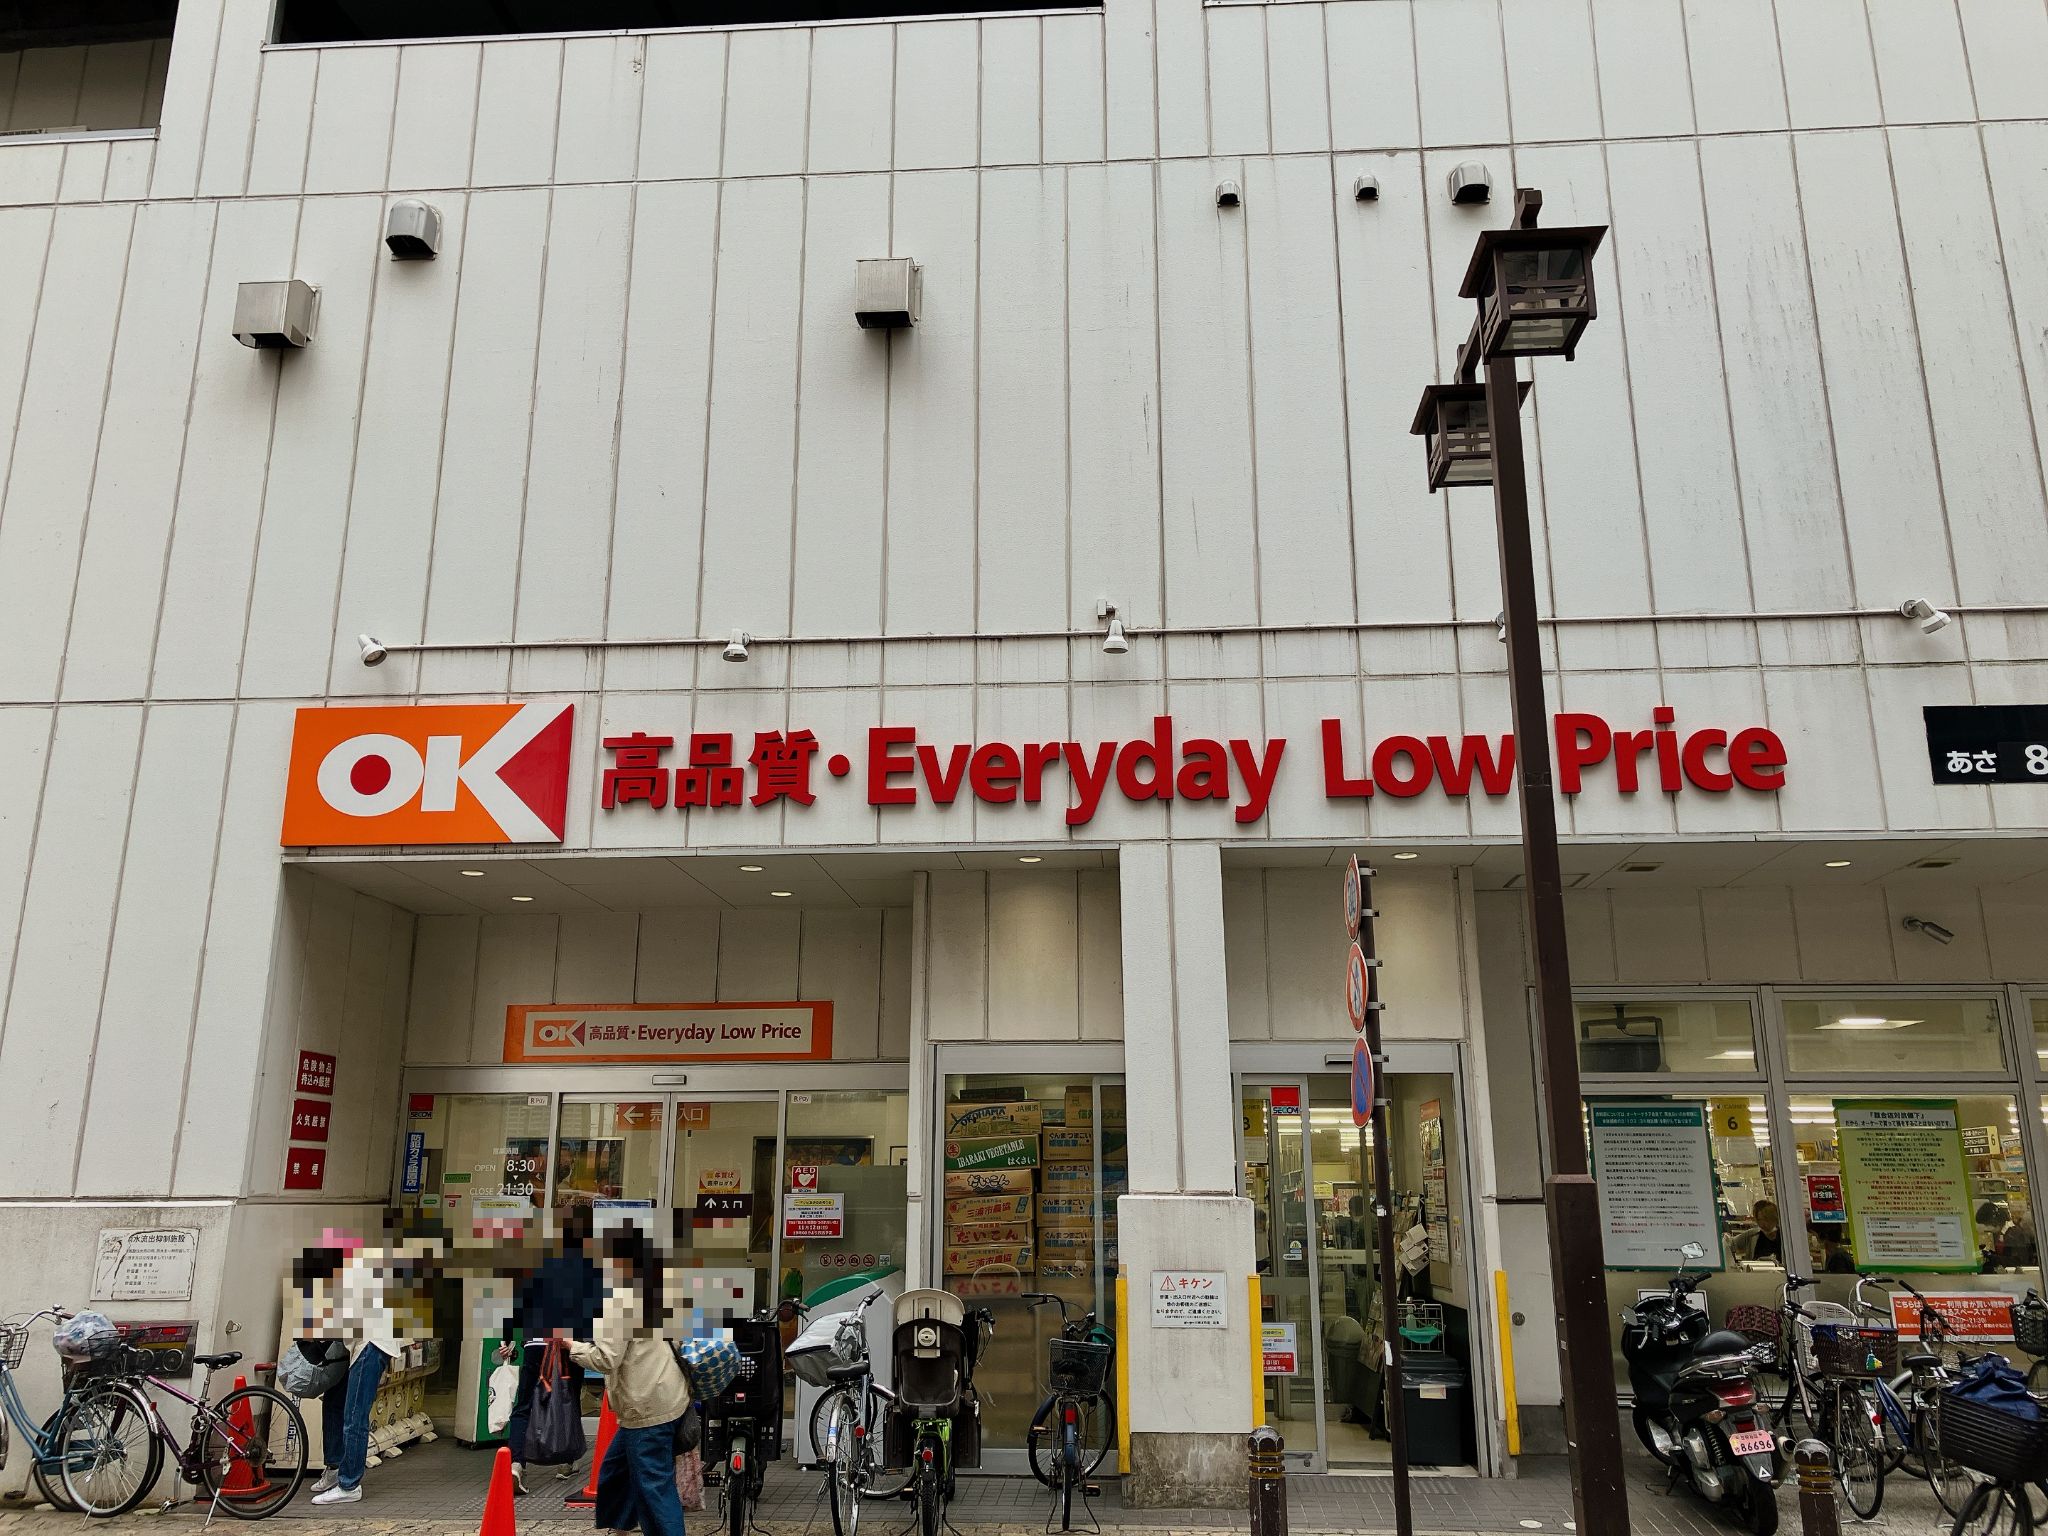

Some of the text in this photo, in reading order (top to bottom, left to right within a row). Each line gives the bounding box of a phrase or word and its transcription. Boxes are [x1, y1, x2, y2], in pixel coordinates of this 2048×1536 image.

[868, 716, 1286, 824] Everyday
[1322, 719, 1516, 801] Low
[1554, 707, 1787, 794] Price
[1946, 750, 1998, 774] あさ
[317, 704, 574, 843] OK
[538, 1019, 586, 1048] OK
[638, 1024, 715, 1044] Everyday
[721, 1023, 756, 1039] Low
[762, 1023, 802, 1039] Price
[1273, 1106, 1300, 1114] SECOM
[1727, 1116, 1739, 1131] 6
[957, 1139, 1025, 1169] IBARAKI VEGETABLE
[1007, 1156, 1036, 1166] はくさい
[474, 1160, 536, 1172] OPEN 8:30
[967, 1174, 1010, 1189] だいこん
[469, 1183, 534, 1196] CLOSE 21:30
[956, 1231, 1019, 1242] だいこん
[1179, 1278, 1213, 1289] キケン
[1740, 1440, 1772, 1452] 86696
